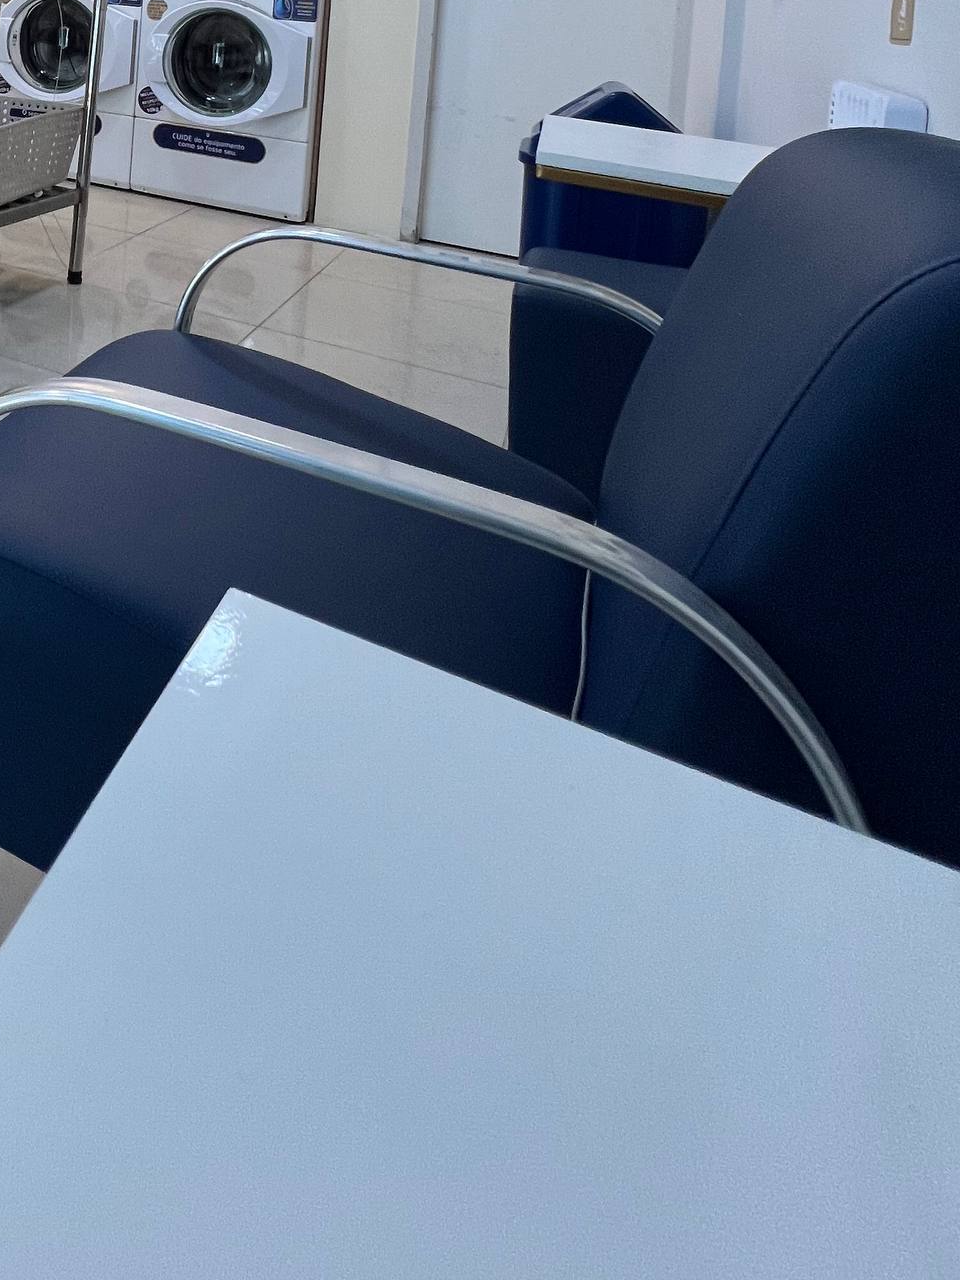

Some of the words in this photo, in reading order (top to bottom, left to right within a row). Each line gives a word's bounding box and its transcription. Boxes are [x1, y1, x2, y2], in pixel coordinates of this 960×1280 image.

[172, 132, 193, 143] CUIDE
[177, 141, 196, 150] como
[205, 145, 223, 154] fosse
